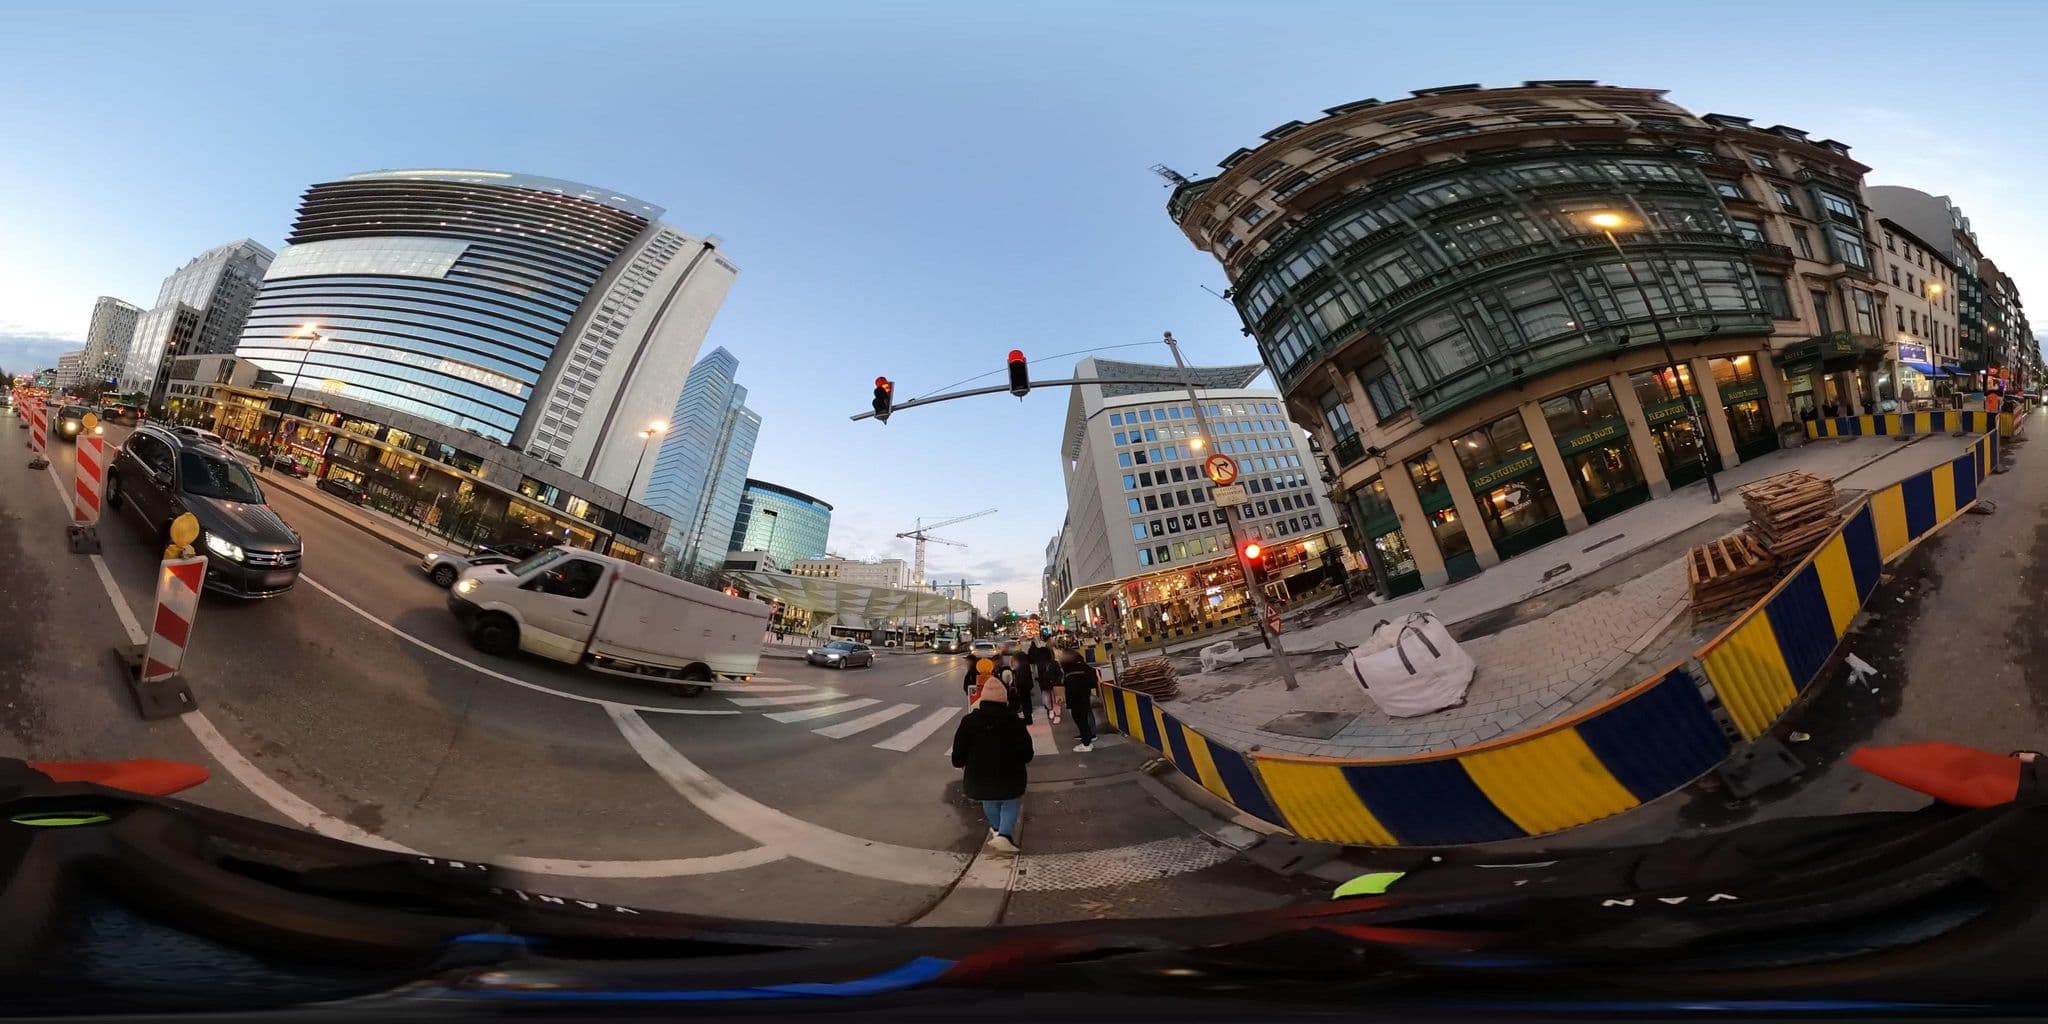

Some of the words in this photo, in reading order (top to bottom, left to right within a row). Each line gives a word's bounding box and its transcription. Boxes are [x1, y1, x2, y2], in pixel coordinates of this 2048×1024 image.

[1648, 400, 1701, 420] RESTAURT
[1473, 456, 1536, 487] RESTAURANT
[1152, 505, 1266, 532] RUXELES
